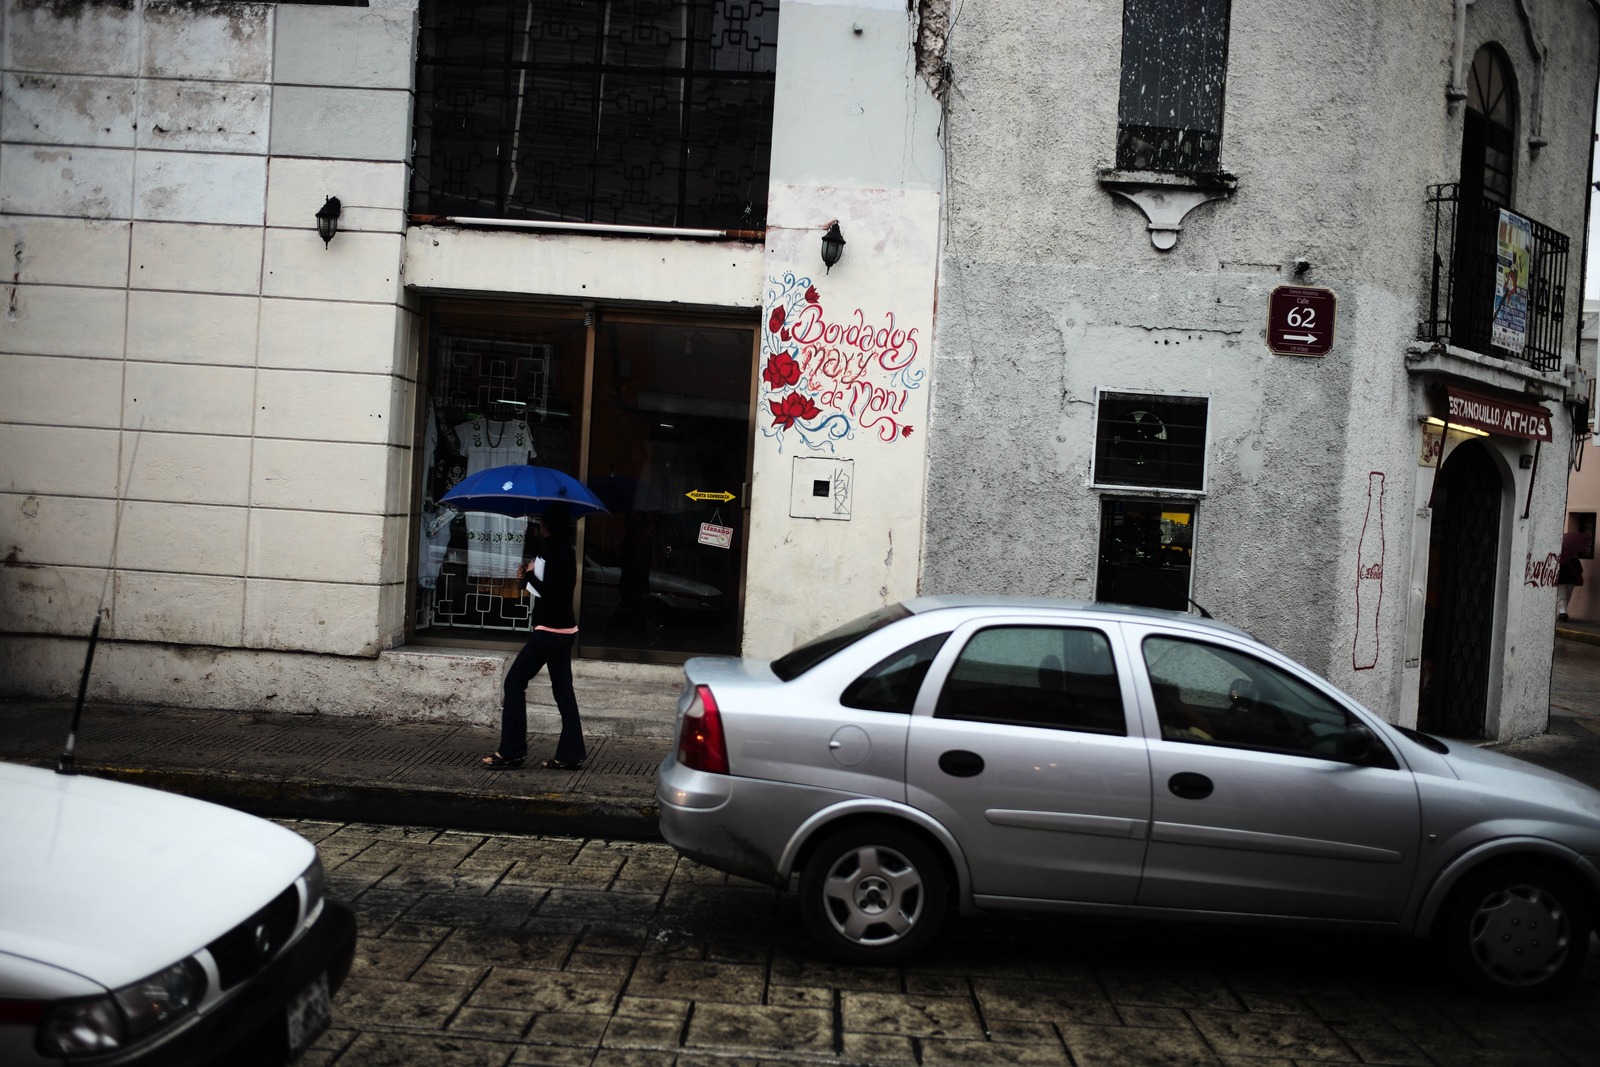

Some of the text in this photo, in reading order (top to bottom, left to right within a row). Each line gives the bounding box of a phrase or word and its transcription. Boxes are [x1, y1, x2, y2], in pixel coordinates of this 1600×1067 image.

[1287, 306, 1316, 328] 62
[791, 304, 919, 370] Bordados
[820, 379, 842, 411] de
[704, 526, 730, 535] CERRADO
